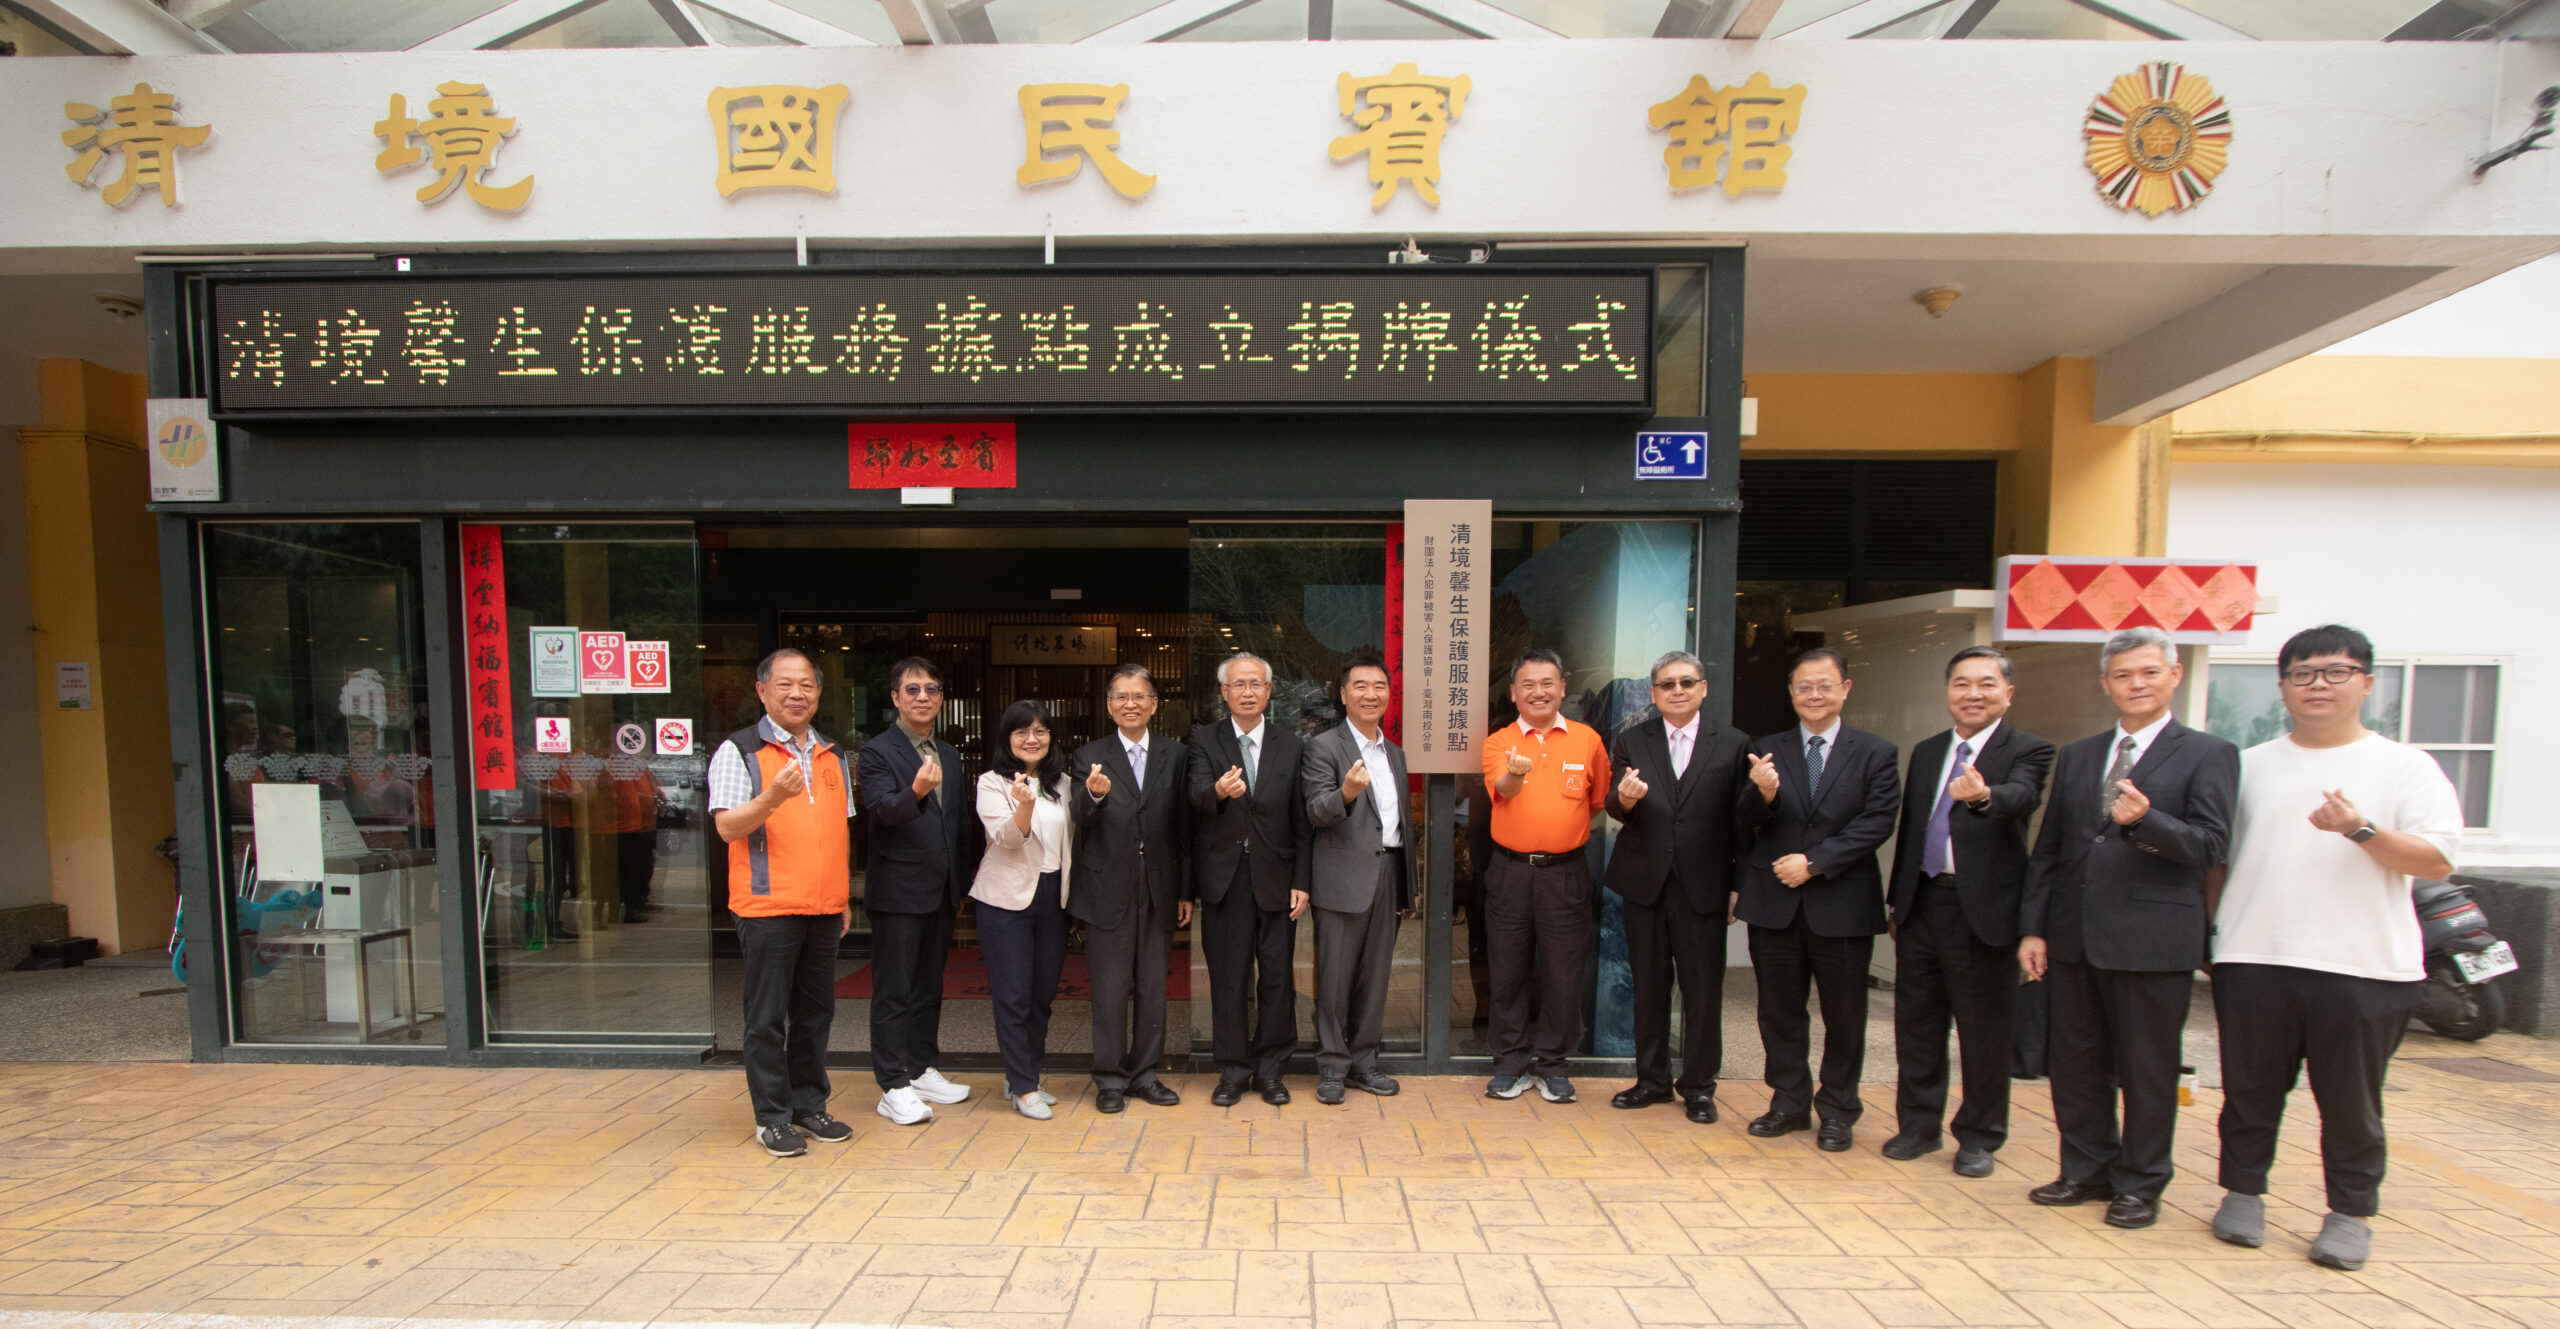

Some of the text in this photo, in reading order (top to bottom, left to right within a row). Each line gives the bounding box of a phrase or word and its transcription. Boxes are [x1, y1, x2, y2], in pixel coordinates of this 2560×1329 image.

[585, 635, 619, 648] AED
[1447, 523, 1471, 752] 清境馨生保護服務據點
[638, 652, 658, 660] AED
